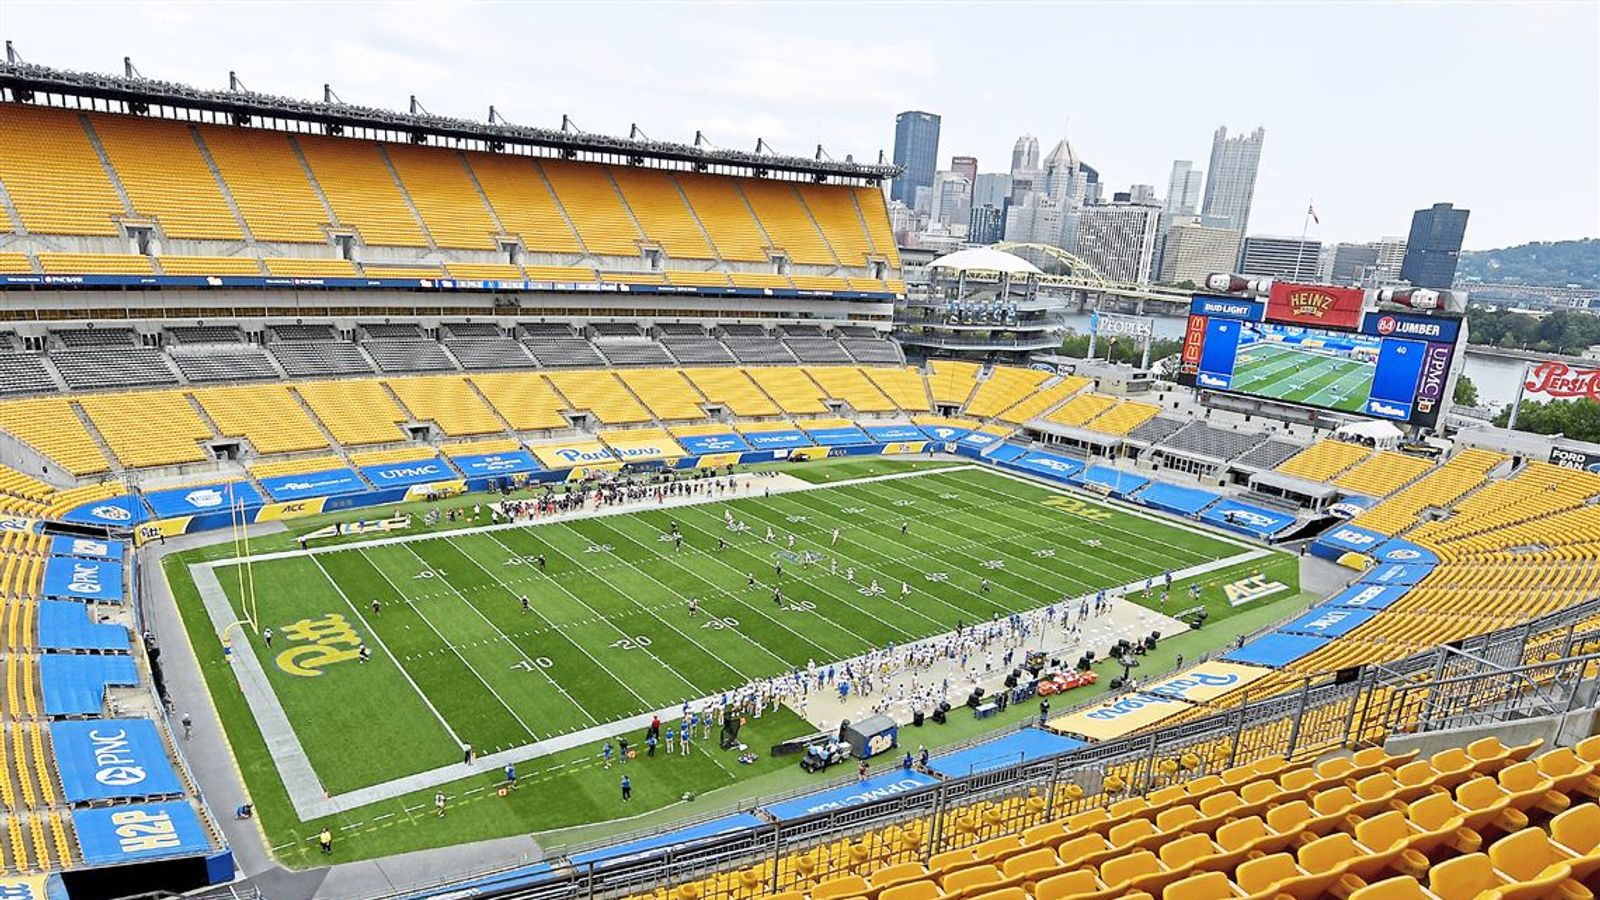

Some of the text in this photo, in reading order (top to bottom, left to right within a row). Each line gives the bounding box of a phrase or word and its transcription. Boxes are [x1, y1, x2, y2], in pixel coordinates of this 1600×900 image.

[1204, 303, 1249, 315] BUD LIGHT
[1291, 293, 1333, 310] HEINZ
[1100, 317, 1152, 337] PEOPLES
[1379, 319, 1440, 336] 84 LUMBER
[1424, 348, 1448, 396] UPMC
[1552, 450, 1586, 463] FORD
[379, 465, 440, 479] UPMC
[281, 503, 306, 514] ACC
[709, 616, 740, 630] 30
[616, 635, 653, 651] 20
[521, 656, 554, 672] 10
[89, 729, 135, 767] PNC
[111, 810, 181, 853] H2P
